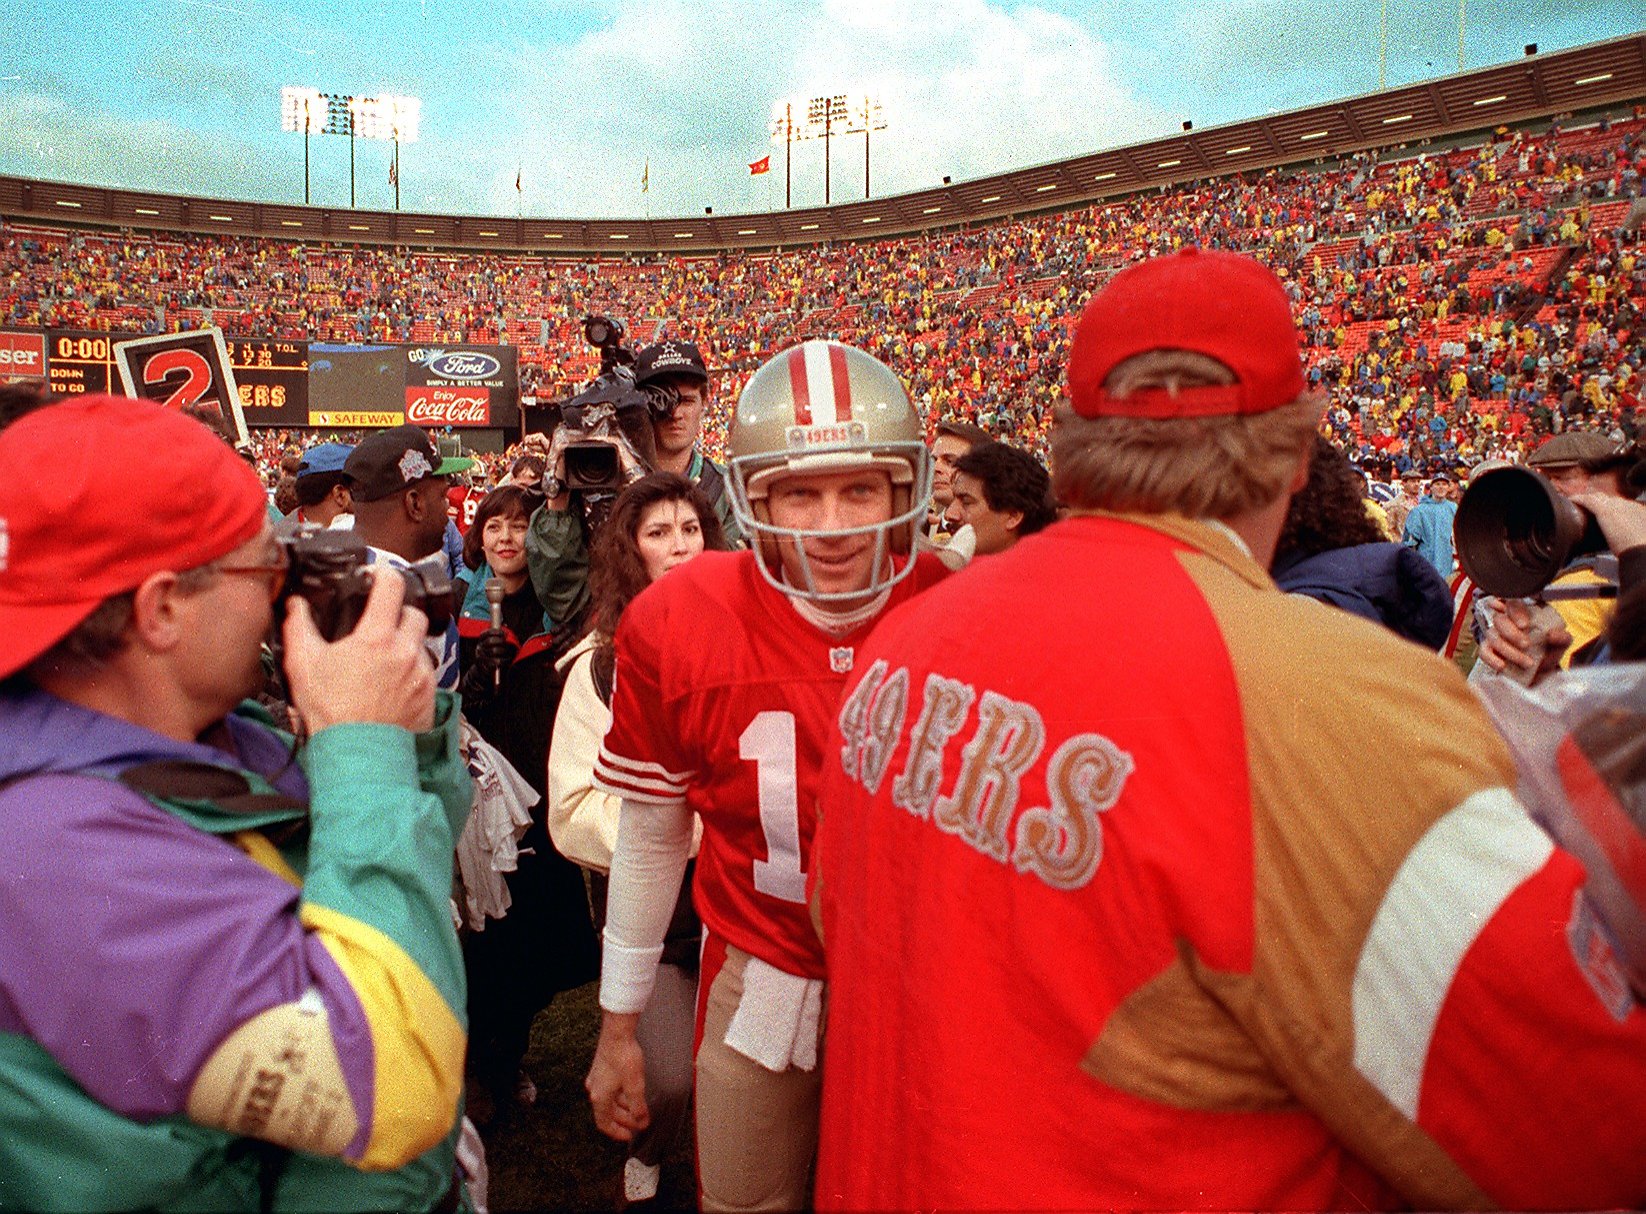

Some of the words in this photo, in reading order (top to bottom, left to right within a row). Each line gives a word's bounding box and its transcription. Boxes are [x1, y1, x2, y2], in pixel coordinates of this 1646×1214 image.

[59, 337, 106, 359] 0:00
[244, 343, 251, 352] 4
[262, 343, 269, 351] T
[243, 350, 255, 359] 13
[258, 350, 272, 359] 30
[408, 348, 424, 363] GO
[658, 352, 682, 360] DALLAS
[258, 358, 272, 367] 20
[444, 356, 486, 374] Ford
[651, 357, 692, 369] COWBOYS
[50, 368, 84, 378] DOWN
[50, 383, 66, 393] TO
[68, 383, 85, 393] GO
[143, 348, 224, 417] 2
[426, 379, 448, 387] SIMPLY
[484, 380, 505, 388] VALUE
[433, 390, 457, 402] Enjoy
[408, 397, 489, 422] Coca-Cola
[335, 414, 396, 424] SAFEWAY
[807, 426, 847, 444] 49ERS
[839, 658, 1136, 892] 49ERS
[738, 710, 808, 904] 1
